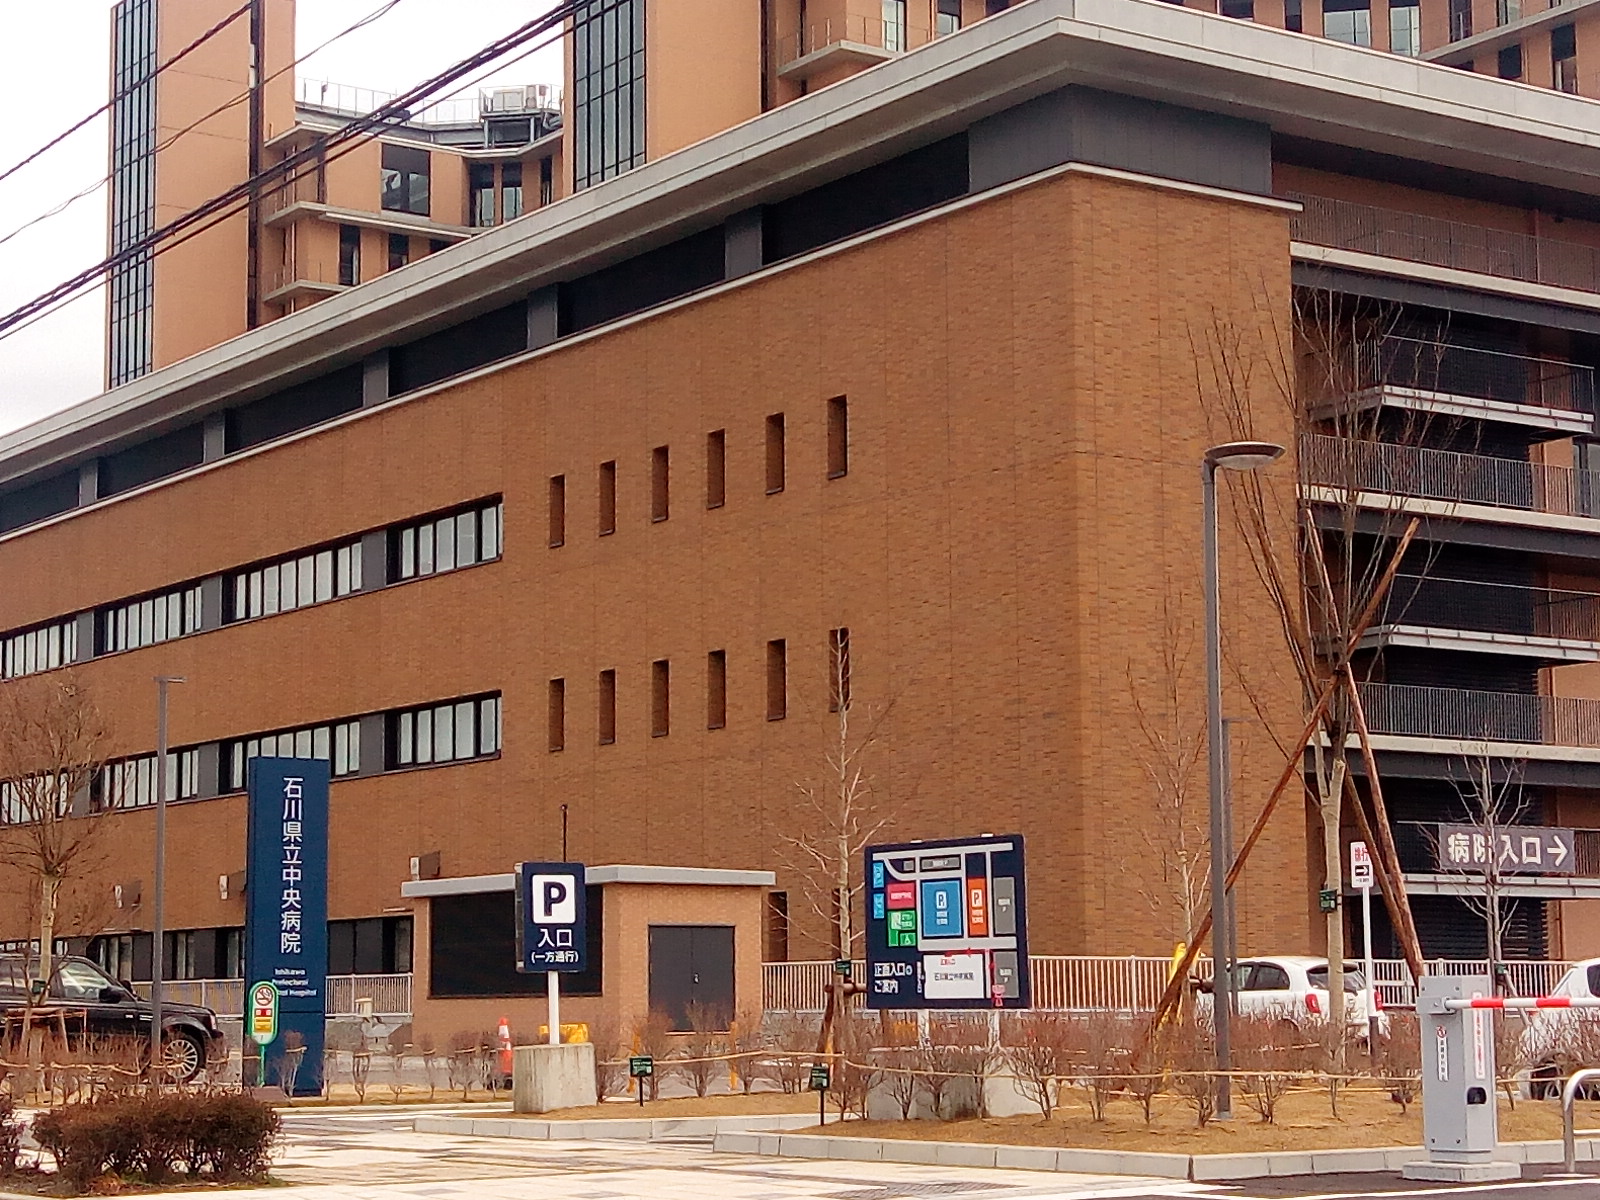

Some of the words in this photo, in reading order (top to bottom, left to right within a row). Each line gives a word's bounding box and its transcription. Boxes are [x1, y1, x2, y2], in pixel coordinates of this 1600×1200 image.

[281, 777, 304, 954] 石川県立中央病院
[543, 881, 567, 917] P
[537, 928, 572, 947] 入口
[531, 951, 579, 963] (一方通行)
